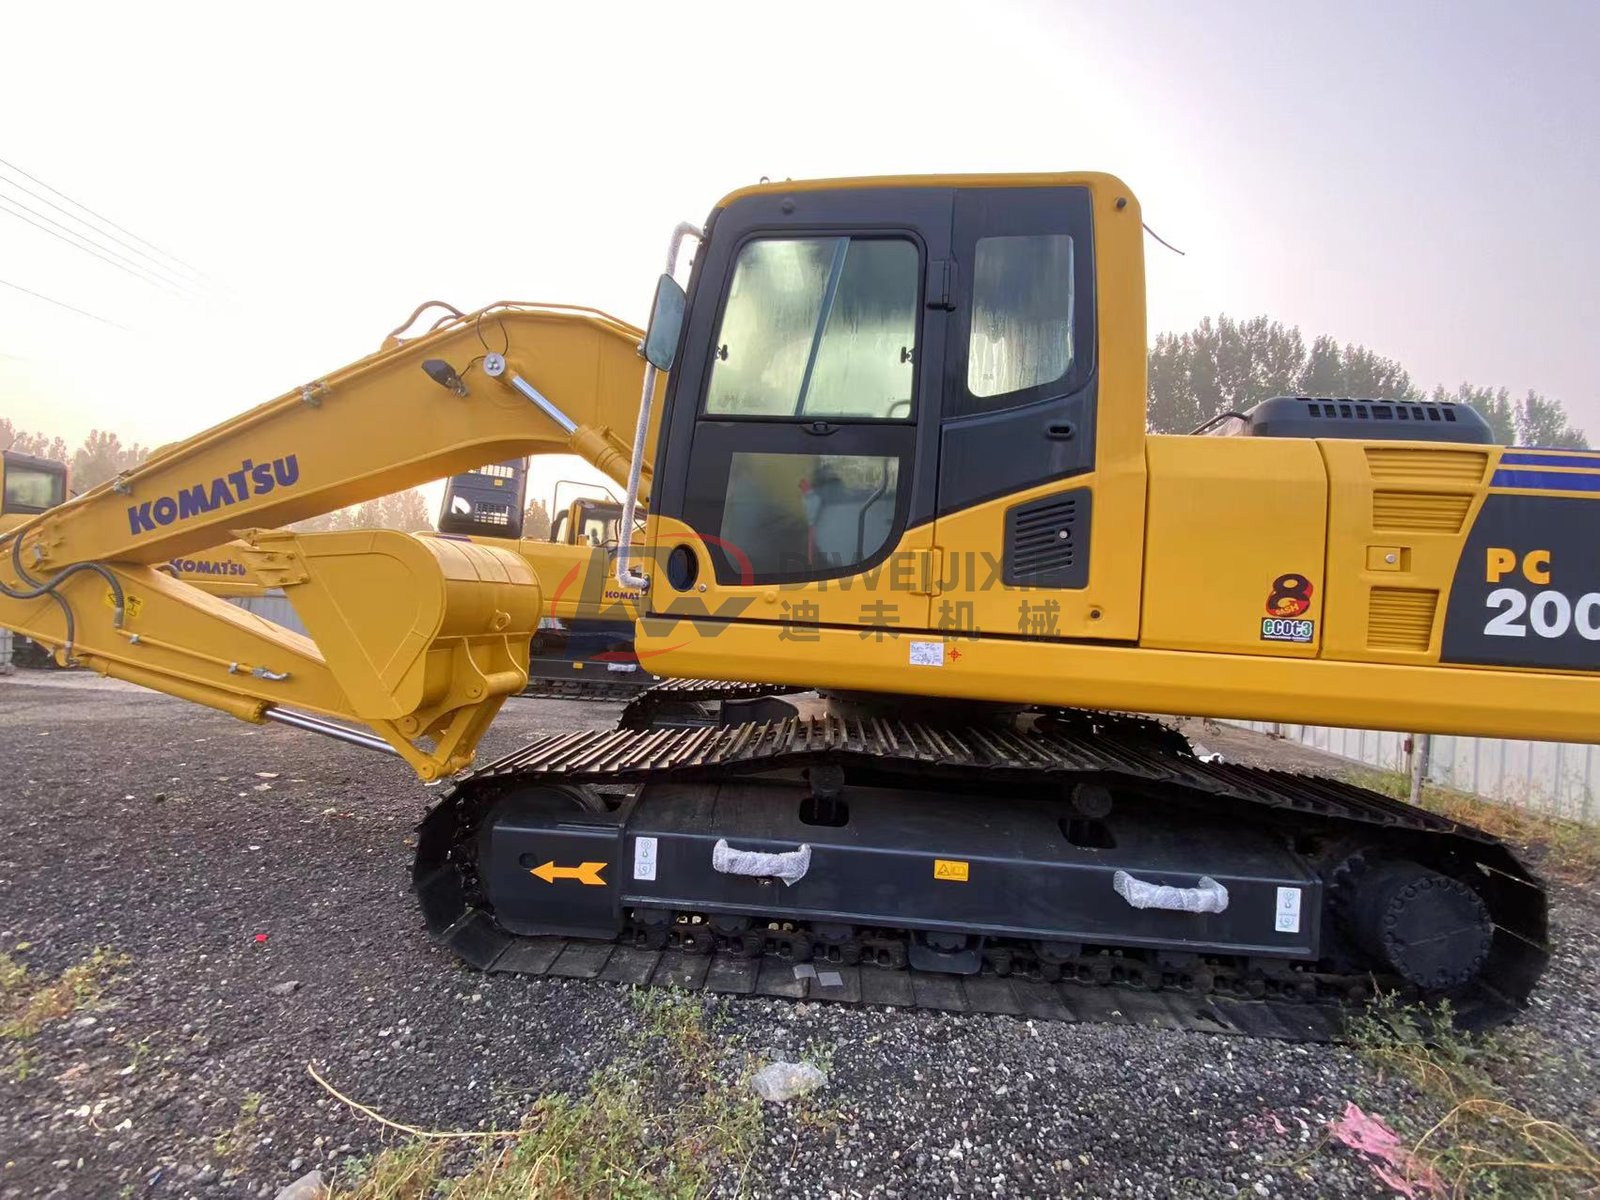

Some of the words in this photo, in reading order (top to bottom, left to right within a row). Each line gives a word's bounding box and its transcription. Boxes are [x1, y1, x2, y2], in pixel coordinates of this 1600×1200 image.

[127, 454, 300, 536] KOMATSU
[169, 558, 246, 576] KOMATSU
[1486, 547, 1551, 585] PC
[605, 590, 640, 600] KOMAT
[1483, 588, 1600, 640] 200
